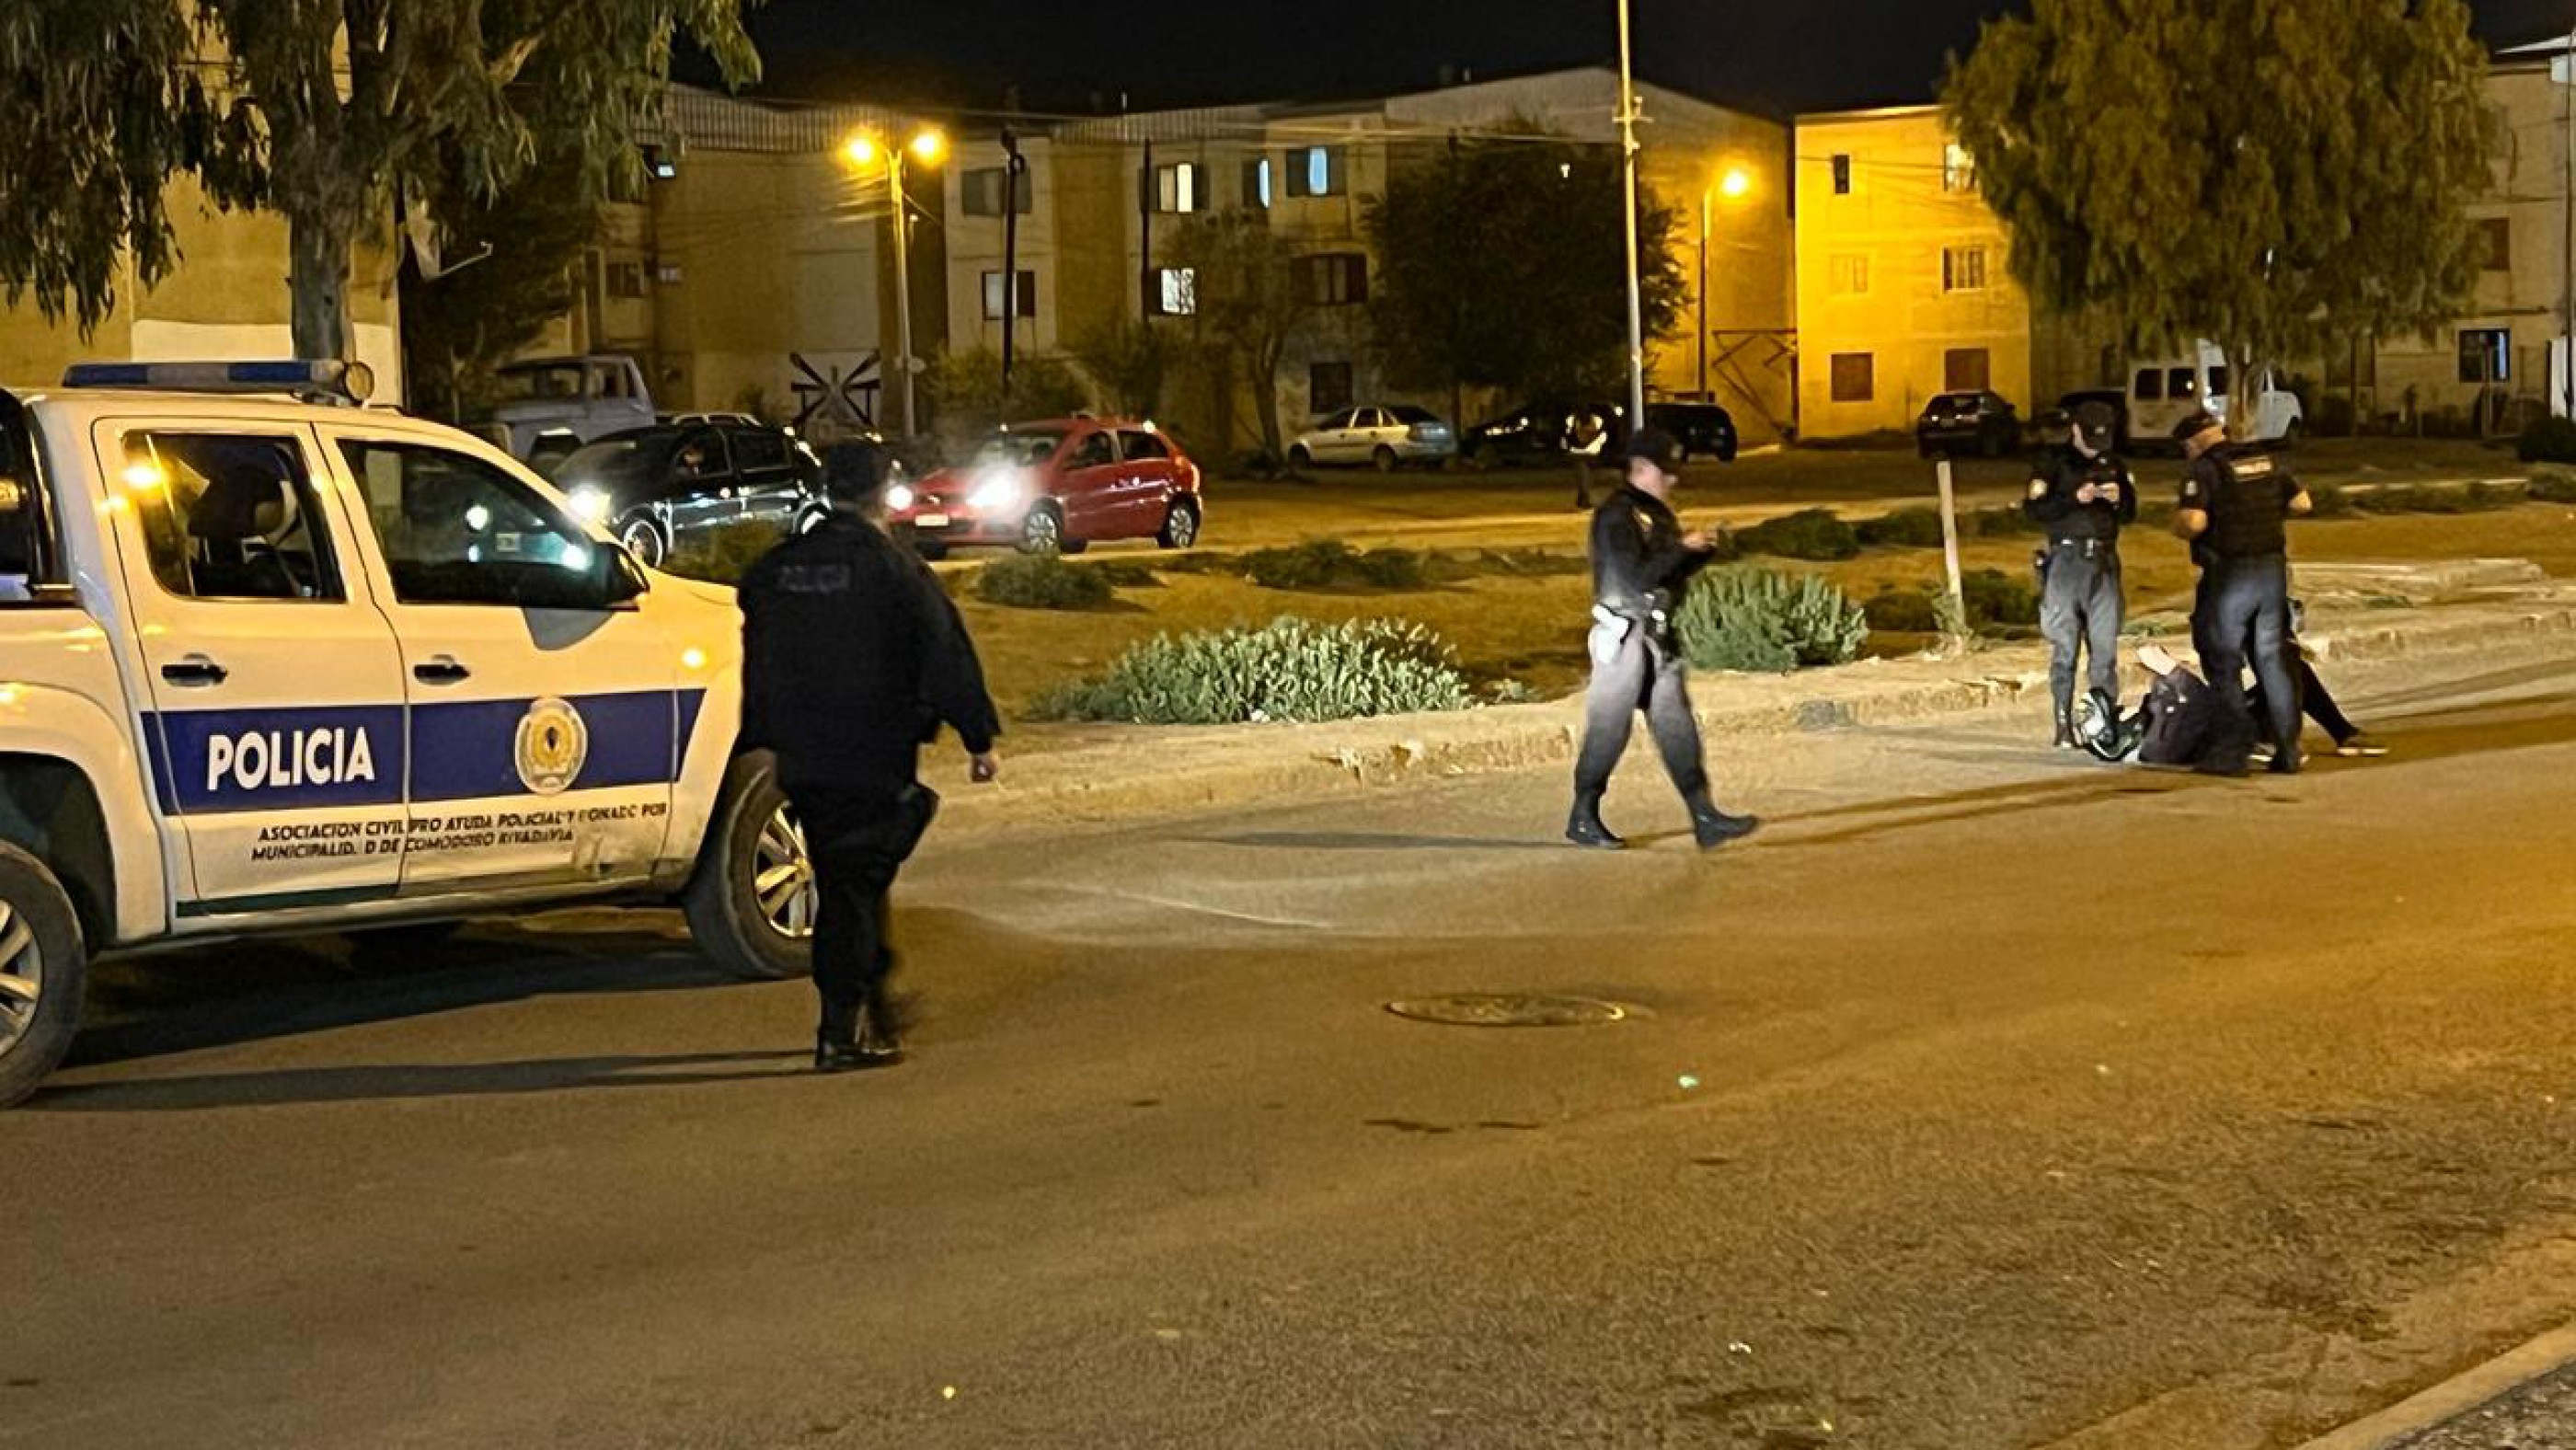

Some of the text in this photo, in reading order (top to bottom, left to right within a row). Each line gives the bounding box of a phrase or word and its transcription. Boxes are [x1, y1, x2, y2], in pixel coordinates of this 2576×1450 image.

[208, 727, 375, 791] POLICIA
[259, 822, 362, 841] ASOCIACION
[366, 819, 403, 834] CIVIL
